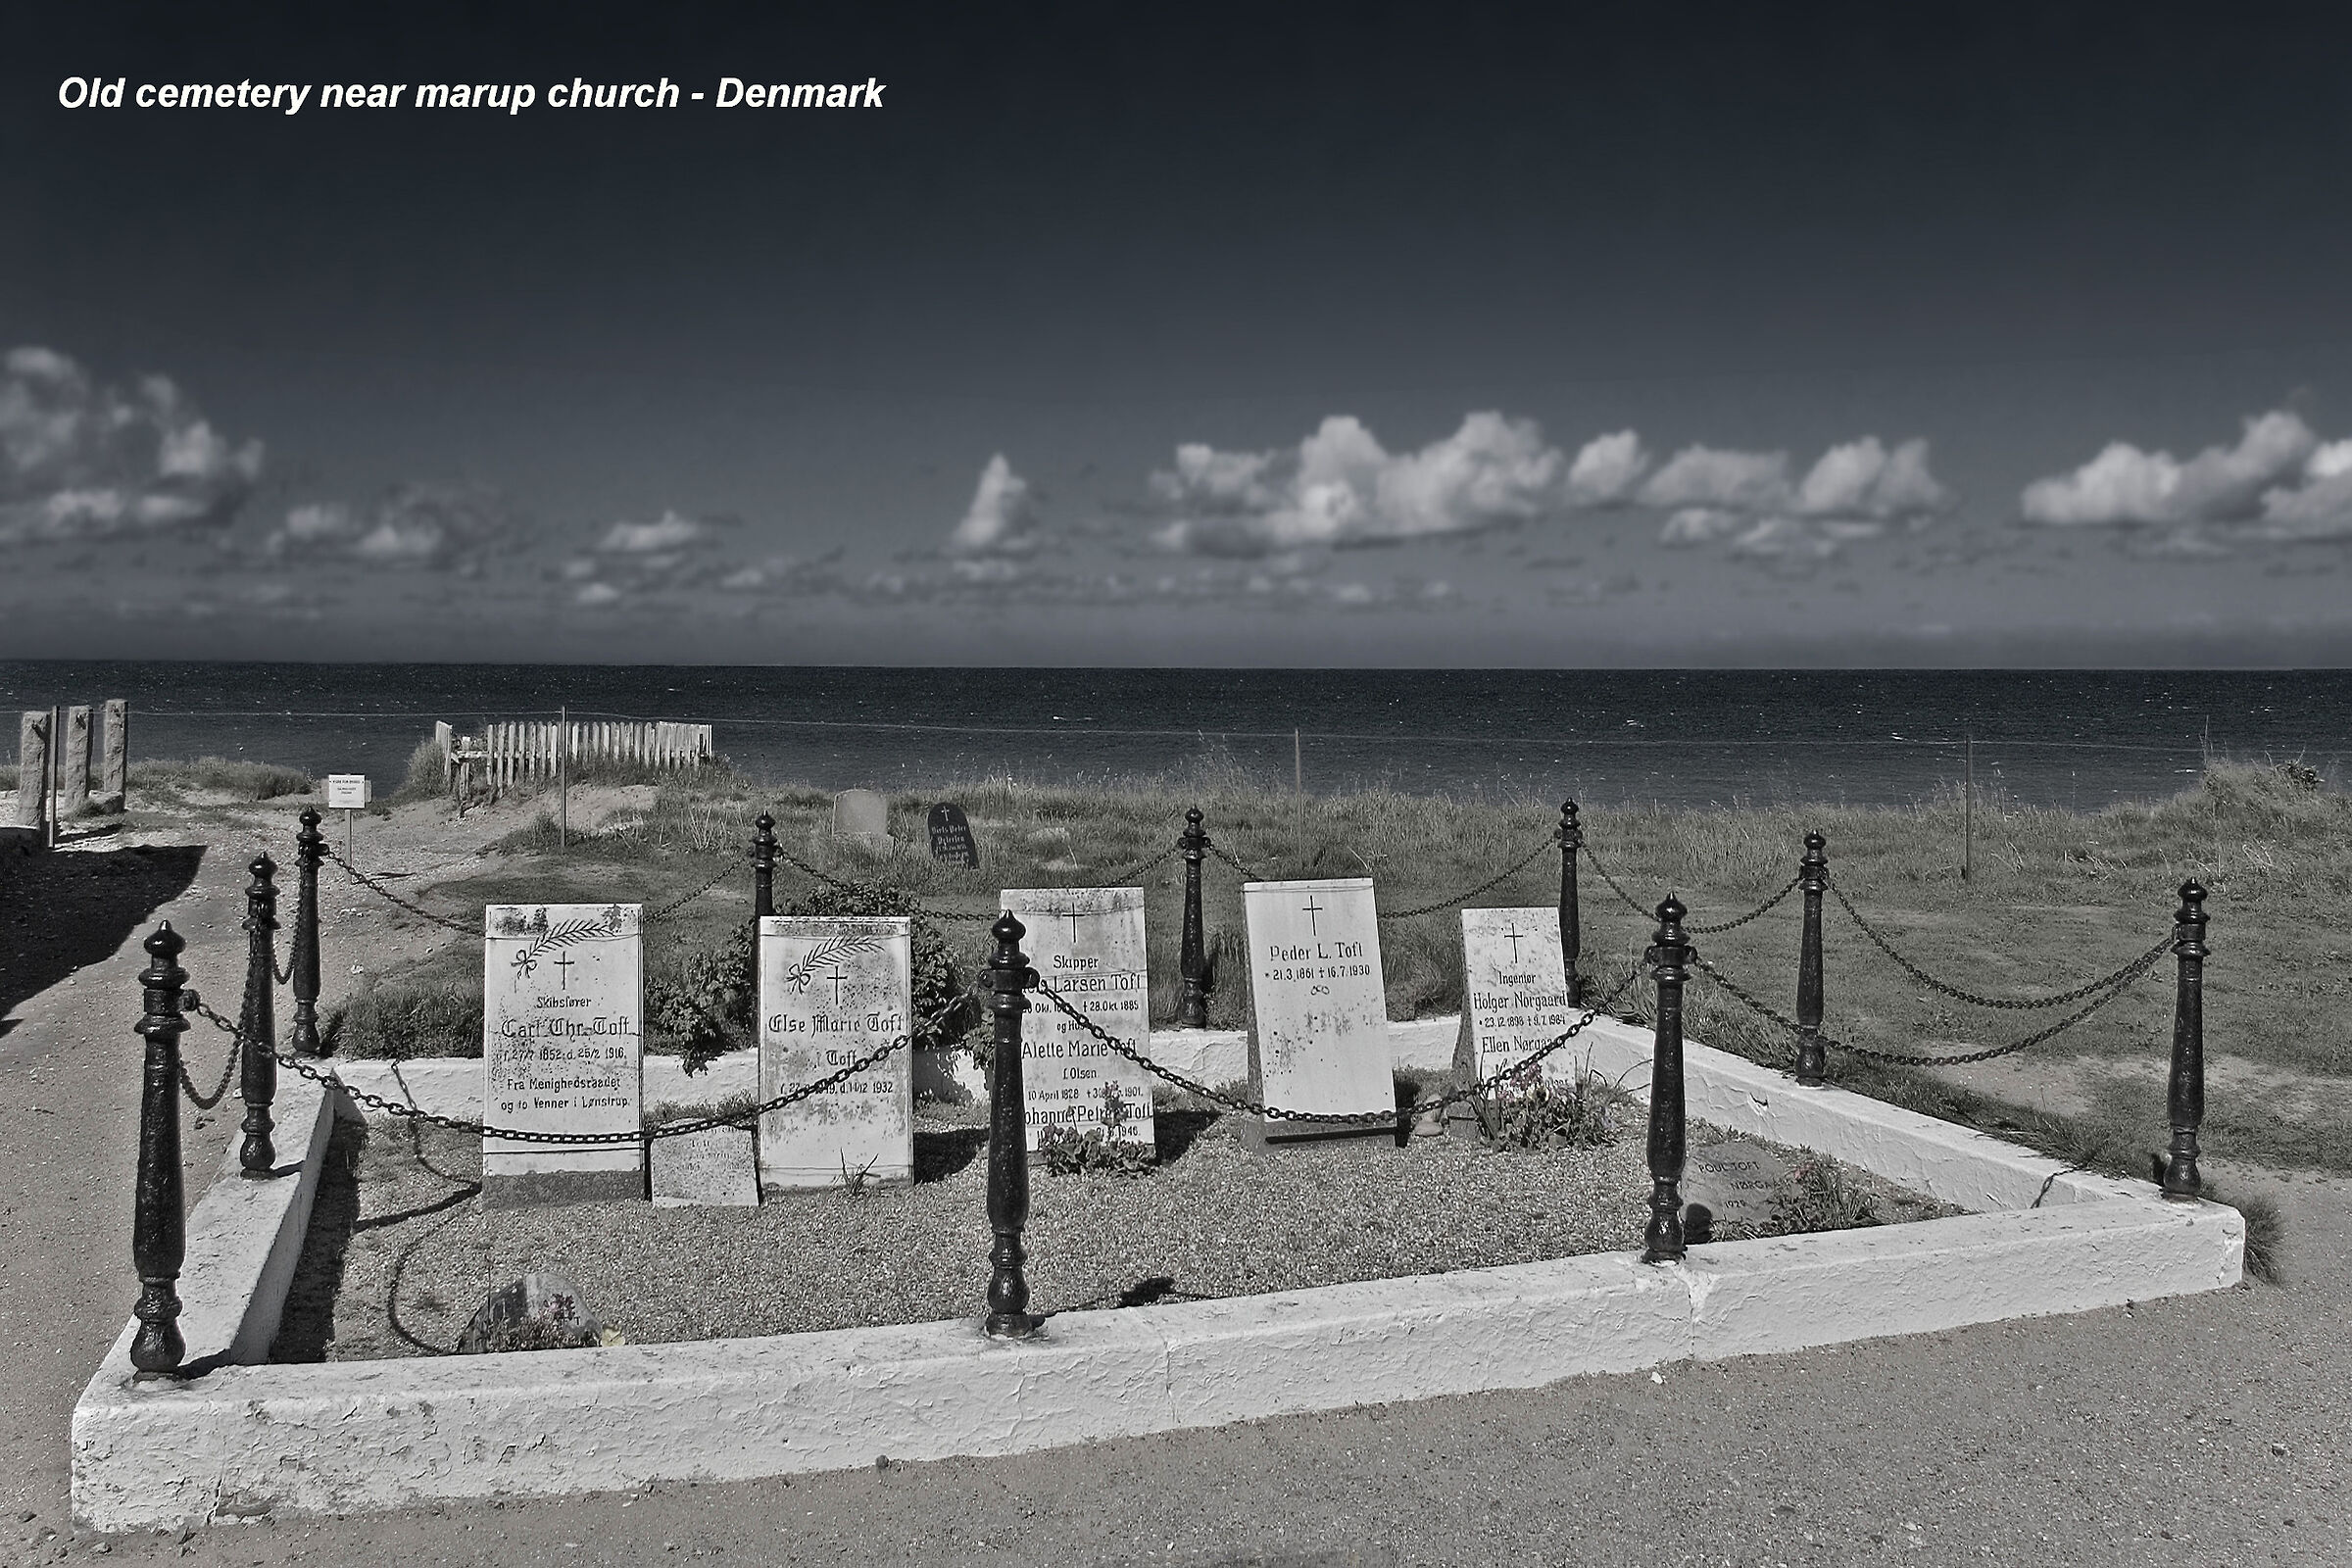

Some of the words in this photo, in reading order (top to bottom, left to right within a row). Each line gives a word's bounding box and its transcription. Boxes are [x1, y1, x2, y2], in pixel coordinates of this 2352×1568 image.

[1269, 944, 1311, 961] Peder
[1317, 943, 1333, 959] L.
[1335, 941, 1363, 958] Toft
[1053, 955, 1099, 970] Skipper
[1054, 975, 1106, 993] Larsen
[1110, 972, 1141, 991] Toft
[536, 996, 592, 1008] Skibsfører
[1473, 992, 1509, 1013] Holger
[501, 1018, 540, 1038] Carl
[593, 1016, 630, 1038] Toft
[768, 1013, 806, 1032] Else
[811, 1013, 860, 1038] Marie
[864, 1011, 903, 1034] Toft
[1022, 1041, 1064, 1058] Alette
[1068, 1040, 1108, 1057] Marie
[1482, 1036, 1510, 1054] Ellen
[826, 1049, 857, 1066] Toft
[508, 1078, 525, 1091] Fra
[872, 1081, 893, 1094] 1932
[1039, 1090, 1059, 1102] April
[501, 1102, 514, 1114] og
[534, 1097, 569, 1108] Venner
[573, 1097, 577, 1107] i
[1124, 1102, 1153, 1119] Toft
[1697, 1162, 1729, 1174] POUL
